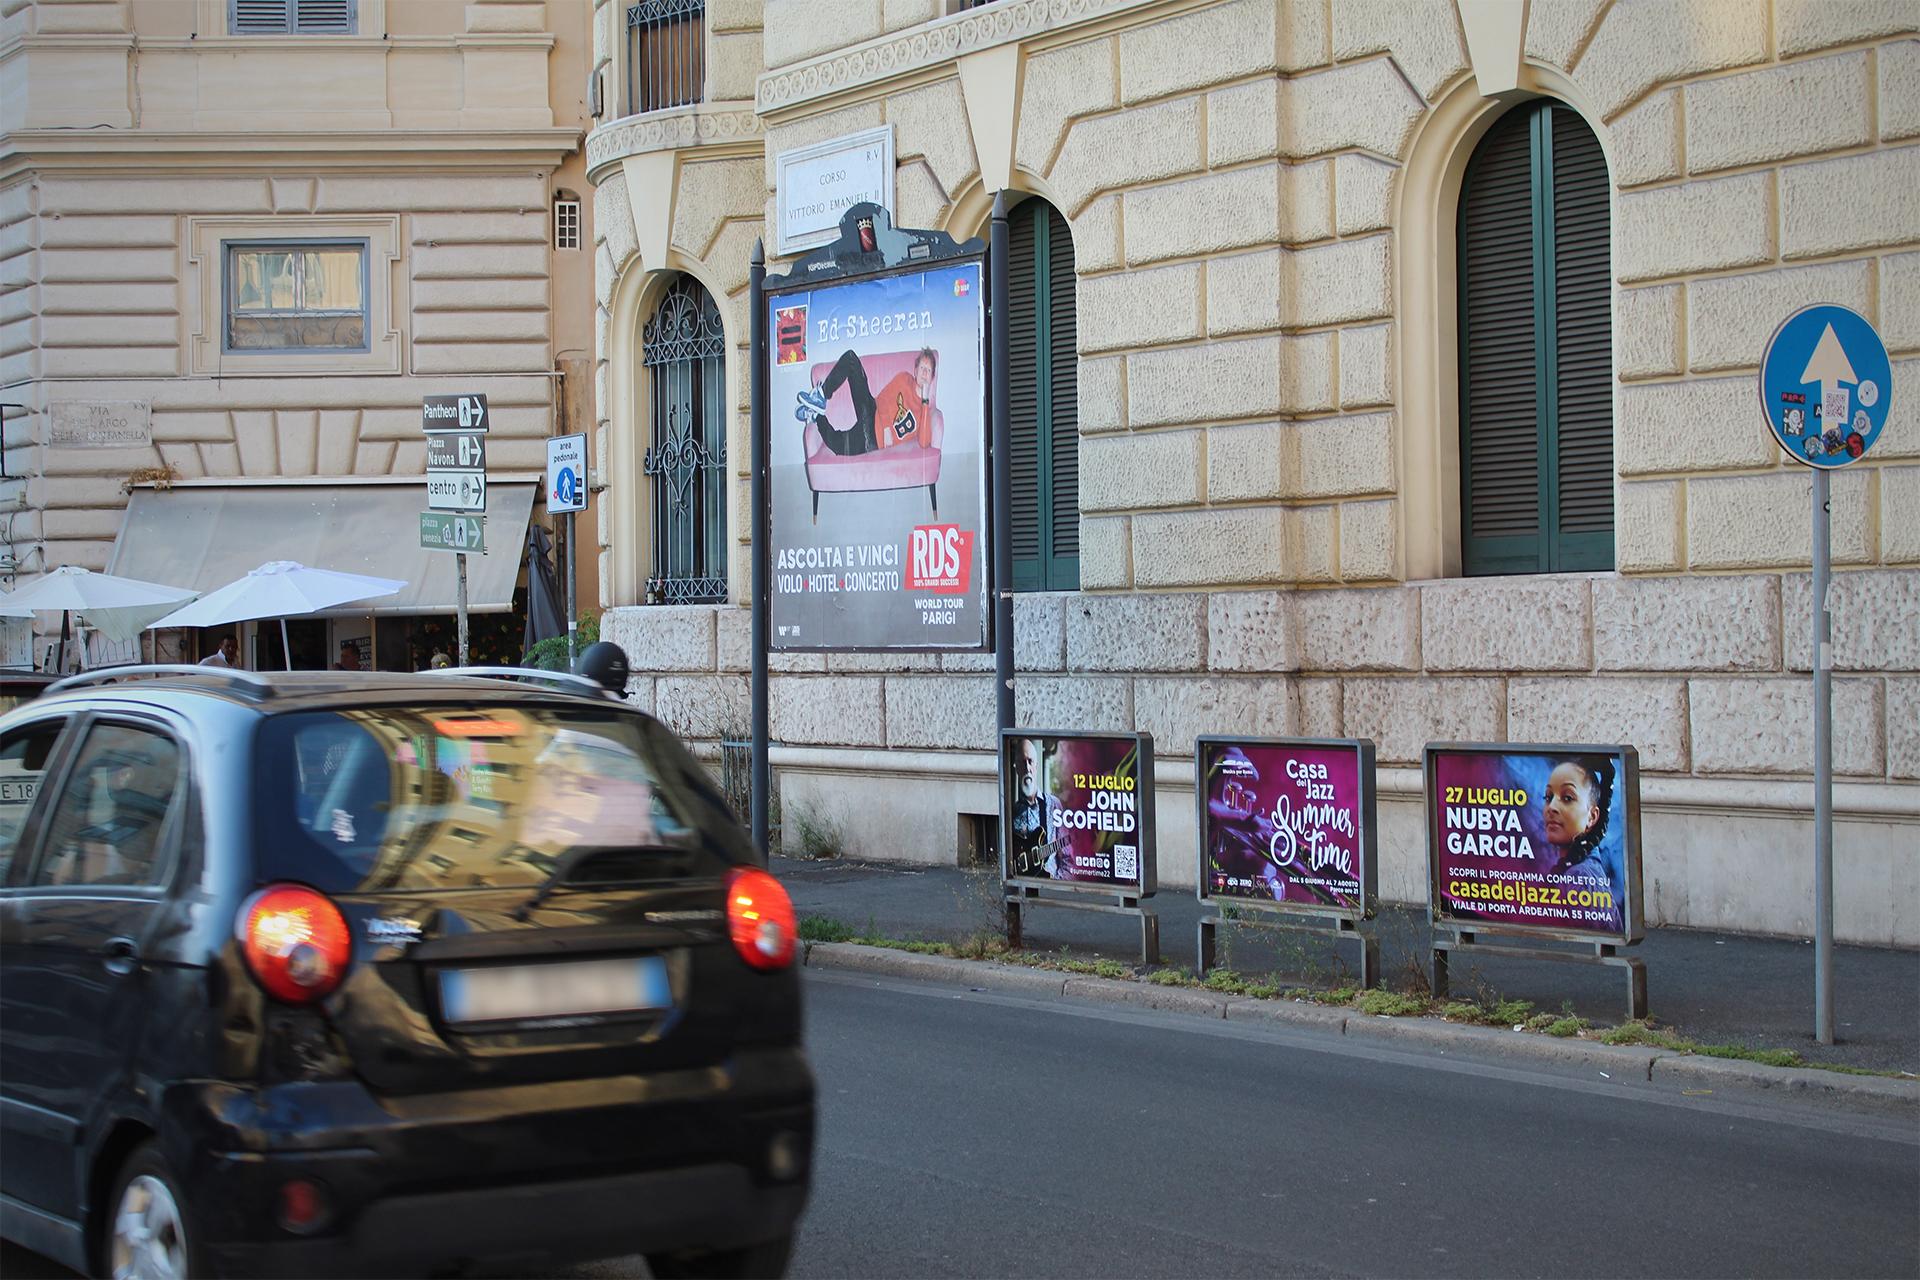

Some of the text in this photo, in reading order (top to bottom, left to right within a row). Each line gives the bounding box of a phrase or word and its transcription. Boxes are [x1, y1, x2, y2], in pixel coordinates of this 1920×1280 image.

[819, 169, 847, 185] CORSO
[788, 202, 825, 220] VITTORIO
[817, 310, 933, 343] Ed Sheeran
[424, 403, 458, 418] Pantheon
[560, 442, 572, 451] area
[428, 451, 455, 466] Navona
[553, 451, 578, 464] pedonale
[429, 480, 457, 495] centro
[778, 544, 899, 570] ASCOLTA E VINCI
[913, 528, 960, 578] RDS
[778, 571, 899, 594] VOLO HOTEL CONCERTO
[914, 599, 964, 609] WORLD TOUR
[922, 611, 956, 625] PARIGI
[1286, 759, 1328, 779] Casa
[1073, 774, 1135, 791] 12 LUGLIO
[1306, 779, 1335, 800] Jazz
[1087, 791, 1135, 812] JOHN
[1445, 786, 1528, 806] 27 LUGLIO
[1052, 808, 1136, 833] SCOFIELD
[1446, 806, 1523, 833] NUBYA
[1270, 794, 1355, 867] Summer
[1447, 832, 1535, 859] GARCIA
[1289, 876, 1300, 884] DAL
[1449, 867, 1611, 888] SCOPRI IL PROGRAMMA COMPLETO SU
[1450, 880, 1613, 909] casadeljazz.com
[1452, 900, 1613, 922] VIALE DI PORTA ARDEATINA 55 ROMA
